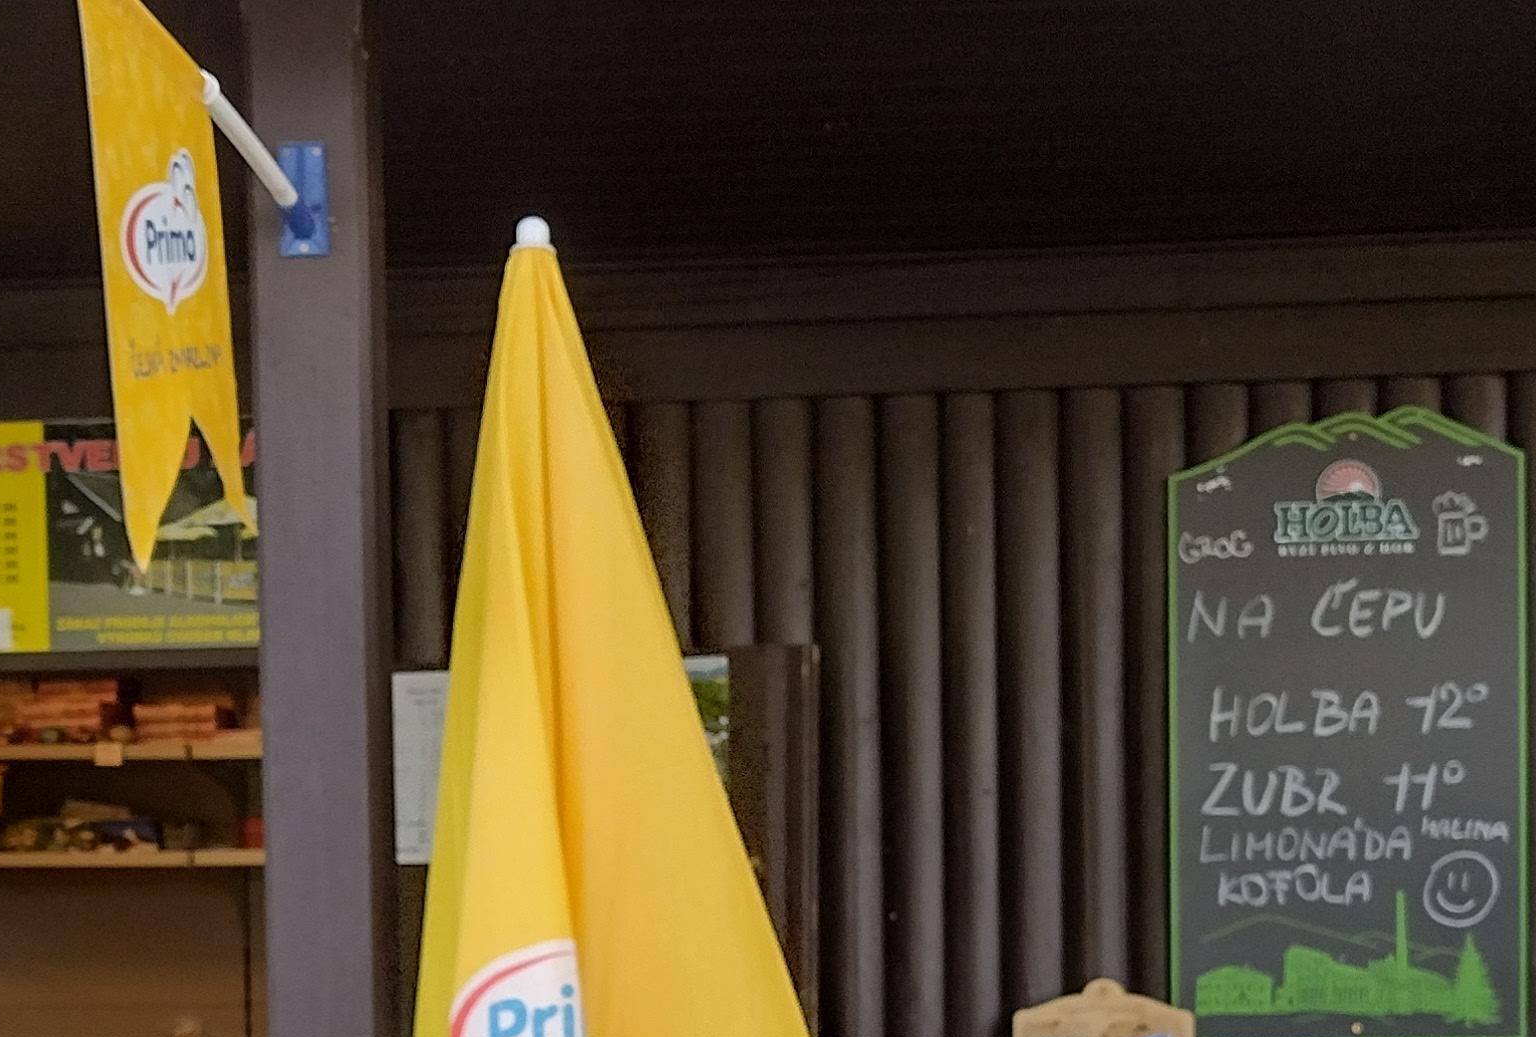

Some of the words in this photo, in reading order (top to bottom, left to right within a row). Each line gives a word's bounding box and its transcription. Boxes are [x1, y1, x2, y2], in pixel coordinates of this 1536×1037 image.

[145, 219, 196, 266] Prima
[1276, 500, 1418, 542] HOLBA
[1187, 590, 1273, 643] NA
[1311, 577, 1446, 639] ČEPU
[1209, 685, 1381, 742] HOLBA
[1201, 762, 1348, 817] ZUBR
[1199, 817, 1412, 864] LIMONÁDA
[1217, 864, 1371, 907] KOFOLA
